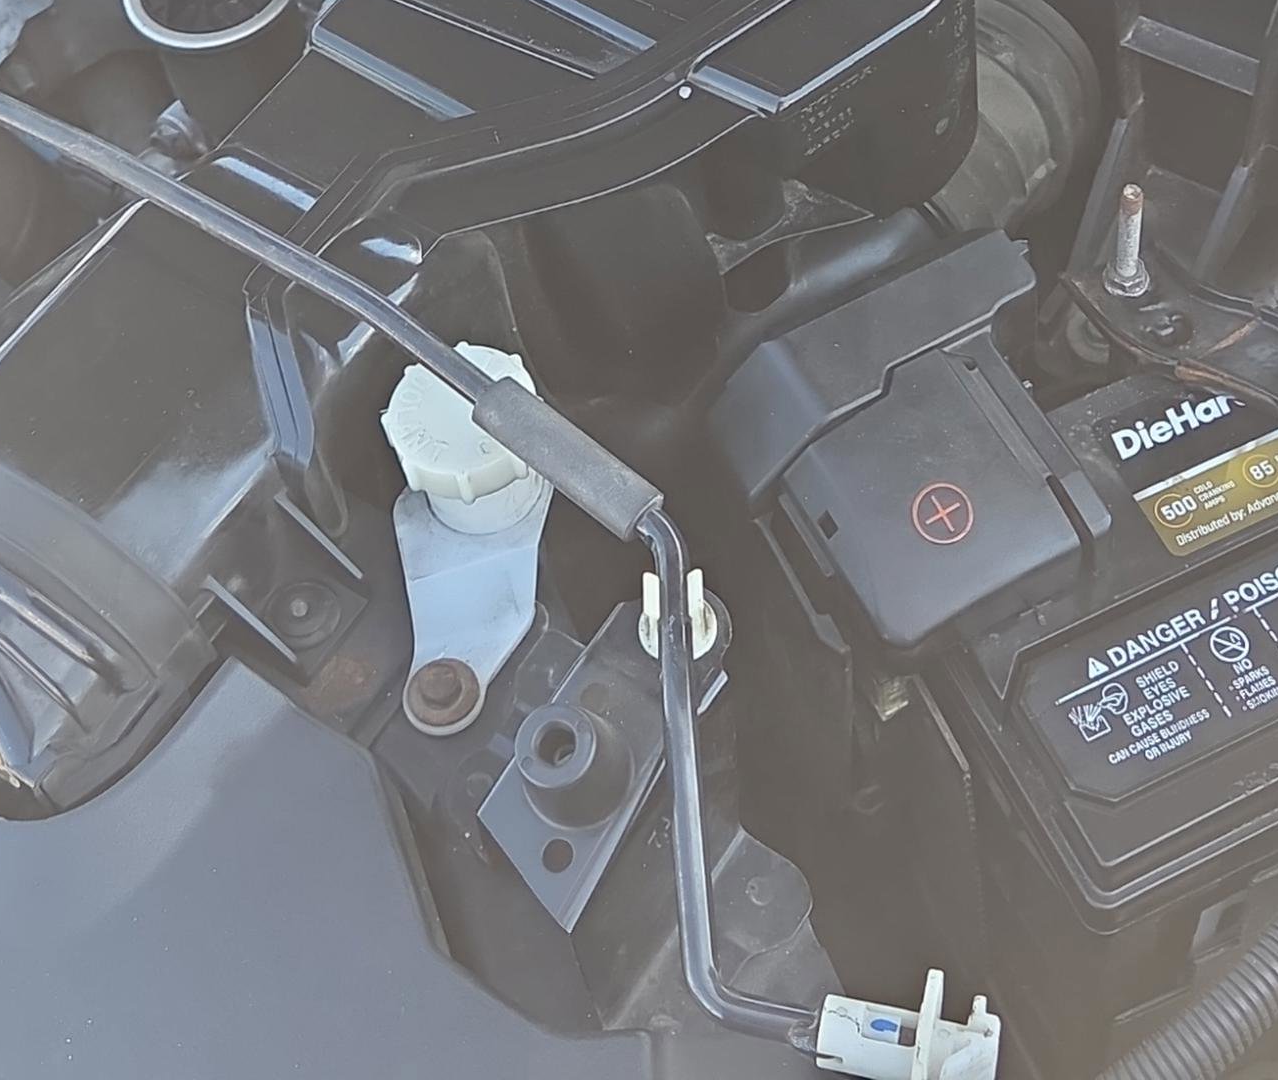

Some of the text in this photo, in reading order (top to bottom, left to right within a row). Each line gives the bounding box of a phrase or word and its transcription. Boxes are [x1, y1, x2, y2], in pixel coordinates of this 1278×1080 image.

[1111, 395, 1246, 460] DieHar
[1251, 461, 1274, 480] 85
[1194, 481, 1214, 495] COLD
[1198, 481, 1236, 502] CRANKING
[1161, 495, 1198, 522] 500
[1204, 495, 1226, 510] AMPS
[1176, 516, 1230, 546] Distributed
[1107, 609, 1206, 667] DANGER
[1136, 661, 1179, 689] SHIELD
[1233, 658, 1253, 674] NO
[1233, 666, 1270, 690] SPARKS
[1143, 677, 1177, 700] EYES
[1239, 677, 1276, 701] FLAMES
[1123, 686, 1190, 726] EXPLOSIVE
[1109, 709, 1210, 765] CAN CAUSE BLINDNESS
[1131, 711, 1173, 738] GASES
[1145, 731, 1192, 760] OR INJURY
